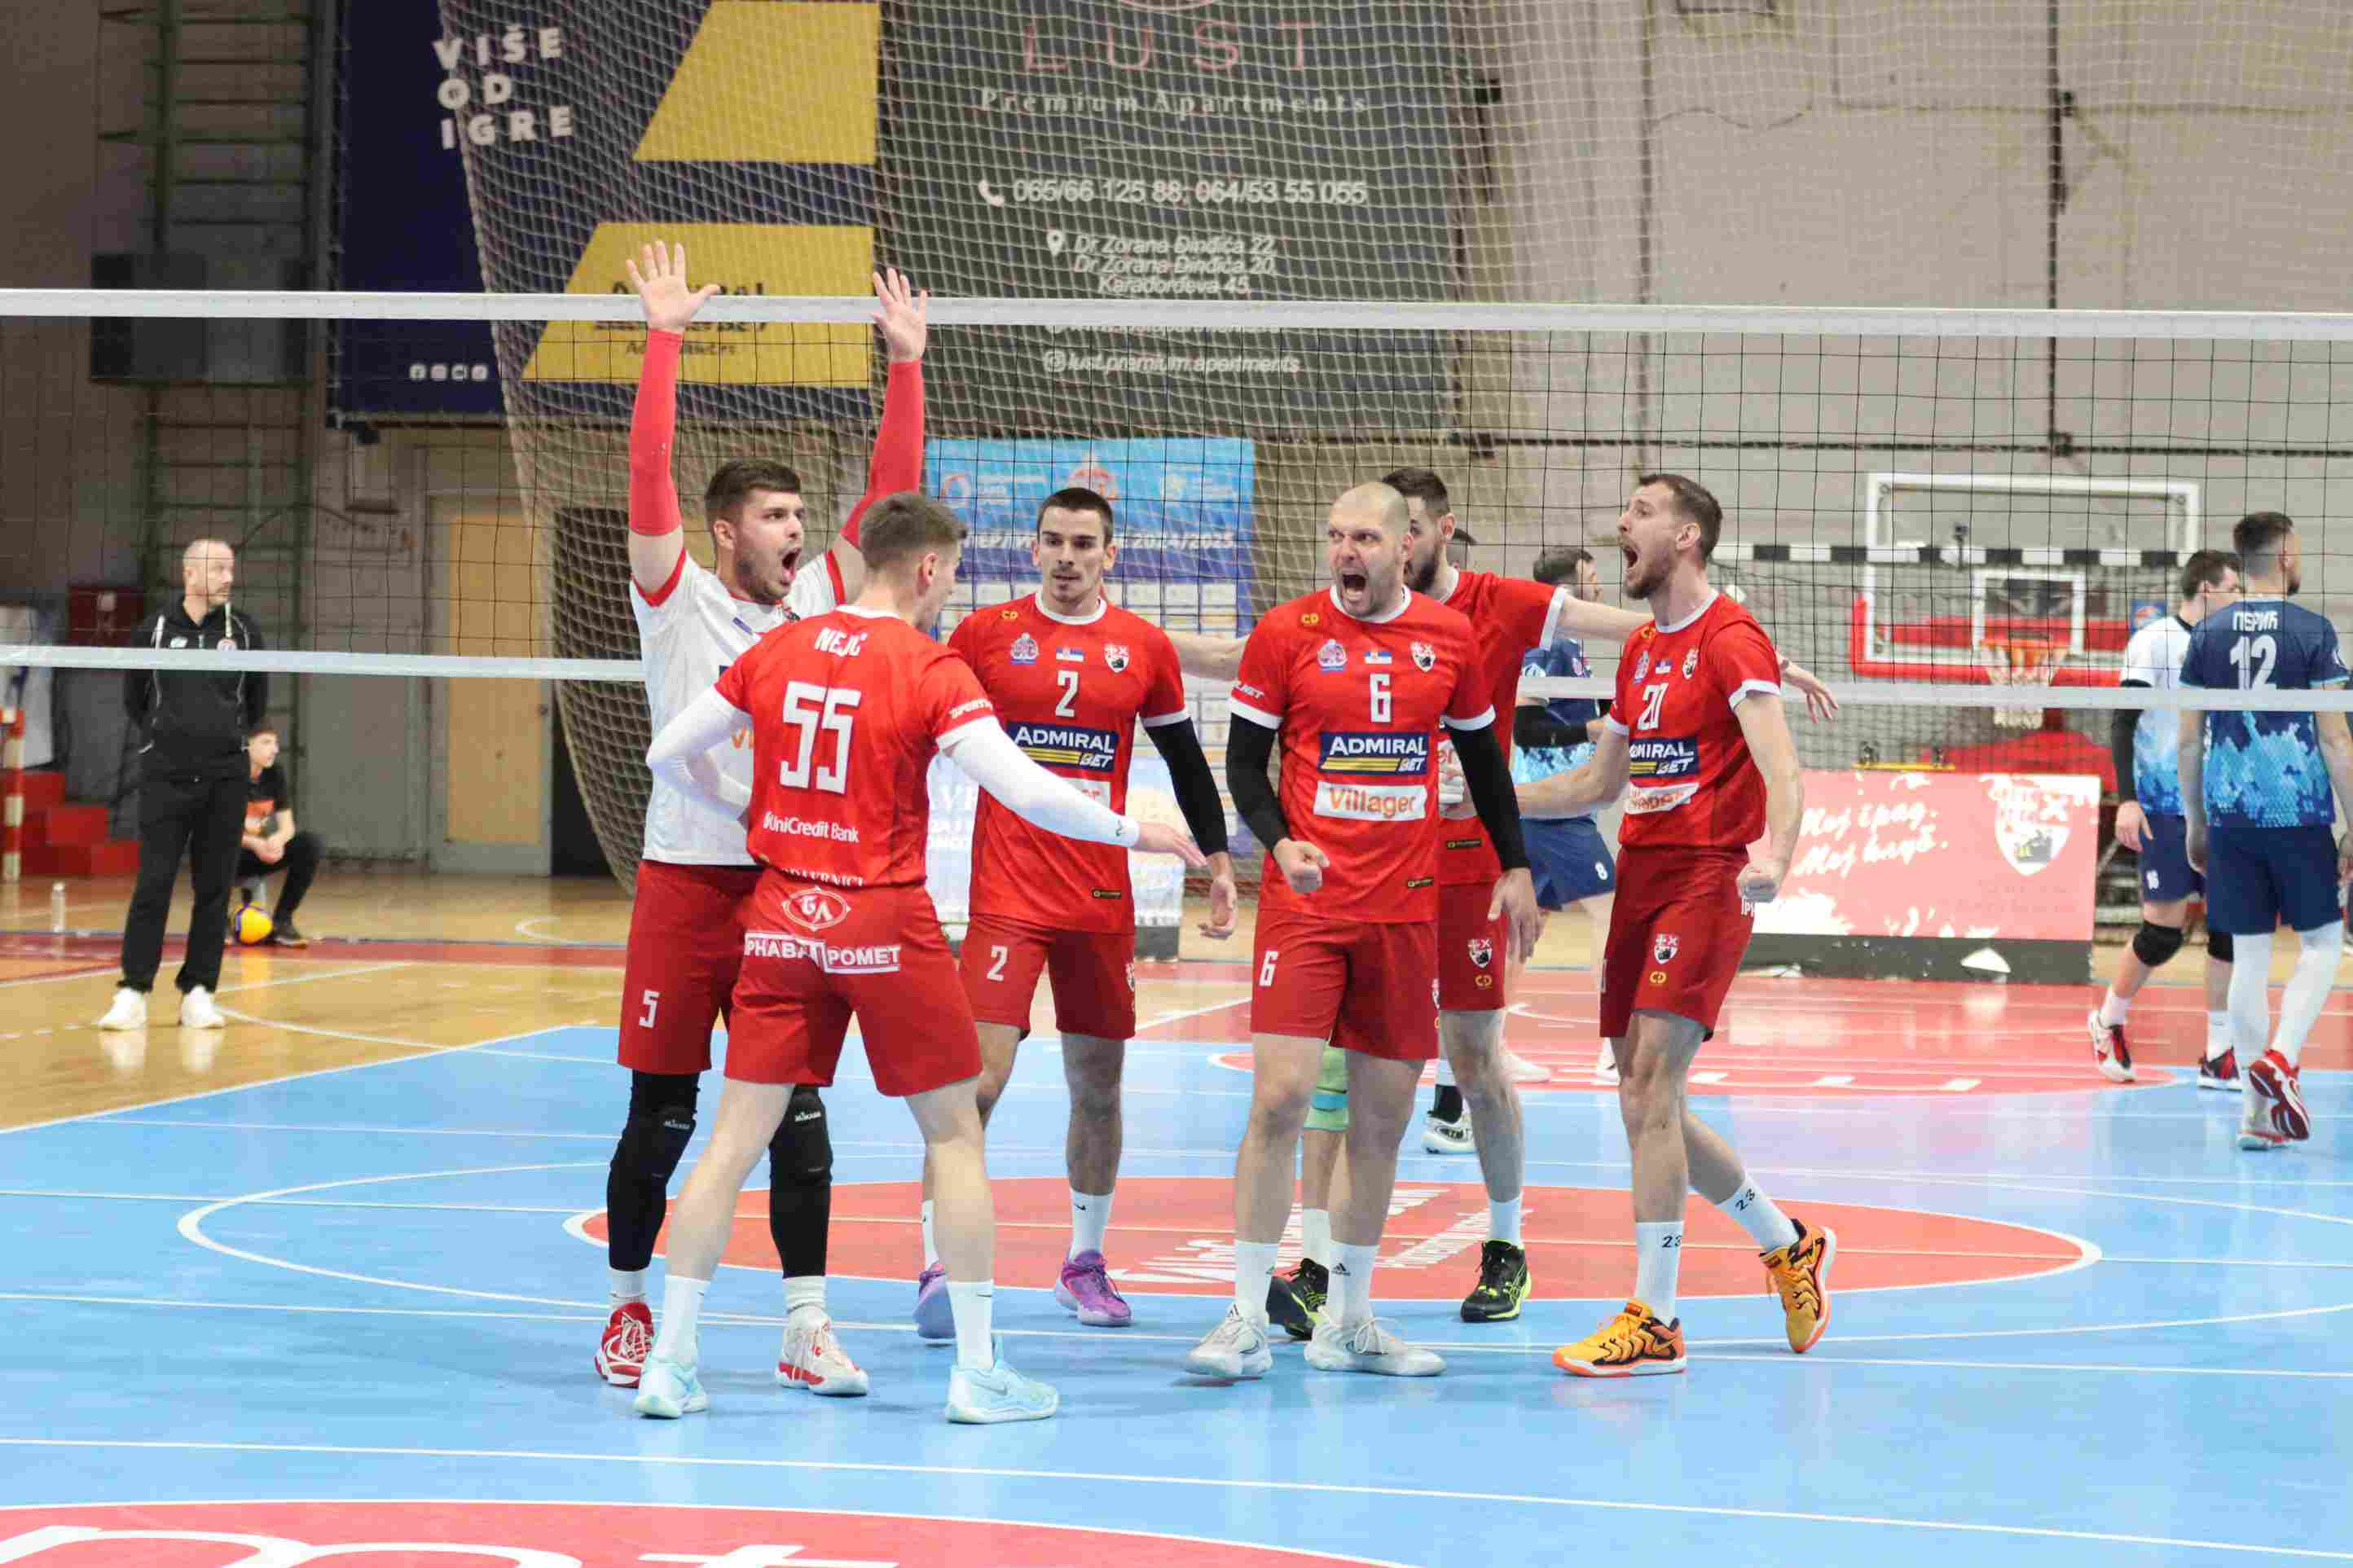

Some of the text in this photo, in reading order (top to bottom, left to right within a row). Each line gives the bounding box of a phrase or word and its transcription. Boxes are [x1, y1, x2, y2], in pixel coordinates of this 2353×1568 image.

[433, 25, 562, 71] VIŠE
[1023, 21, 1317, 72] LUST
[438, 74, 512, 110] OD
[980, 88, 1367, 121] Premium Apartments
[441, 105, 572, 150] IGRE
[1013, 179, 1094, 203] 065/66
[1102, 179, 1146, 203] 125
[1284, 181, 1315, 204] 55
[1320, 181, 1368, 204] 055
[2230, 635, 2277, 691] 12
[1056, 670, 1079, 718] 2
[1370, 674, 1391, 723] 6
[780, 681, 862, 795] 55
[1014, 726, 1115, 753] ADMIRAL
[1330, 736, 1427, 756] ADMIRAL
[1080, 753, 1114, 769] BET
[1397, 758, 1426, 773] BET
[1655, 758, 1694, 775] BET
[1328, 788, 1417, 818] Villager
[768, 815, 860, 843] UniCredit Bank
[987, 945, 1009, 982] 2
[1259, 950, 1279, 987] 6
[638, 989, 660, 1029] 5
